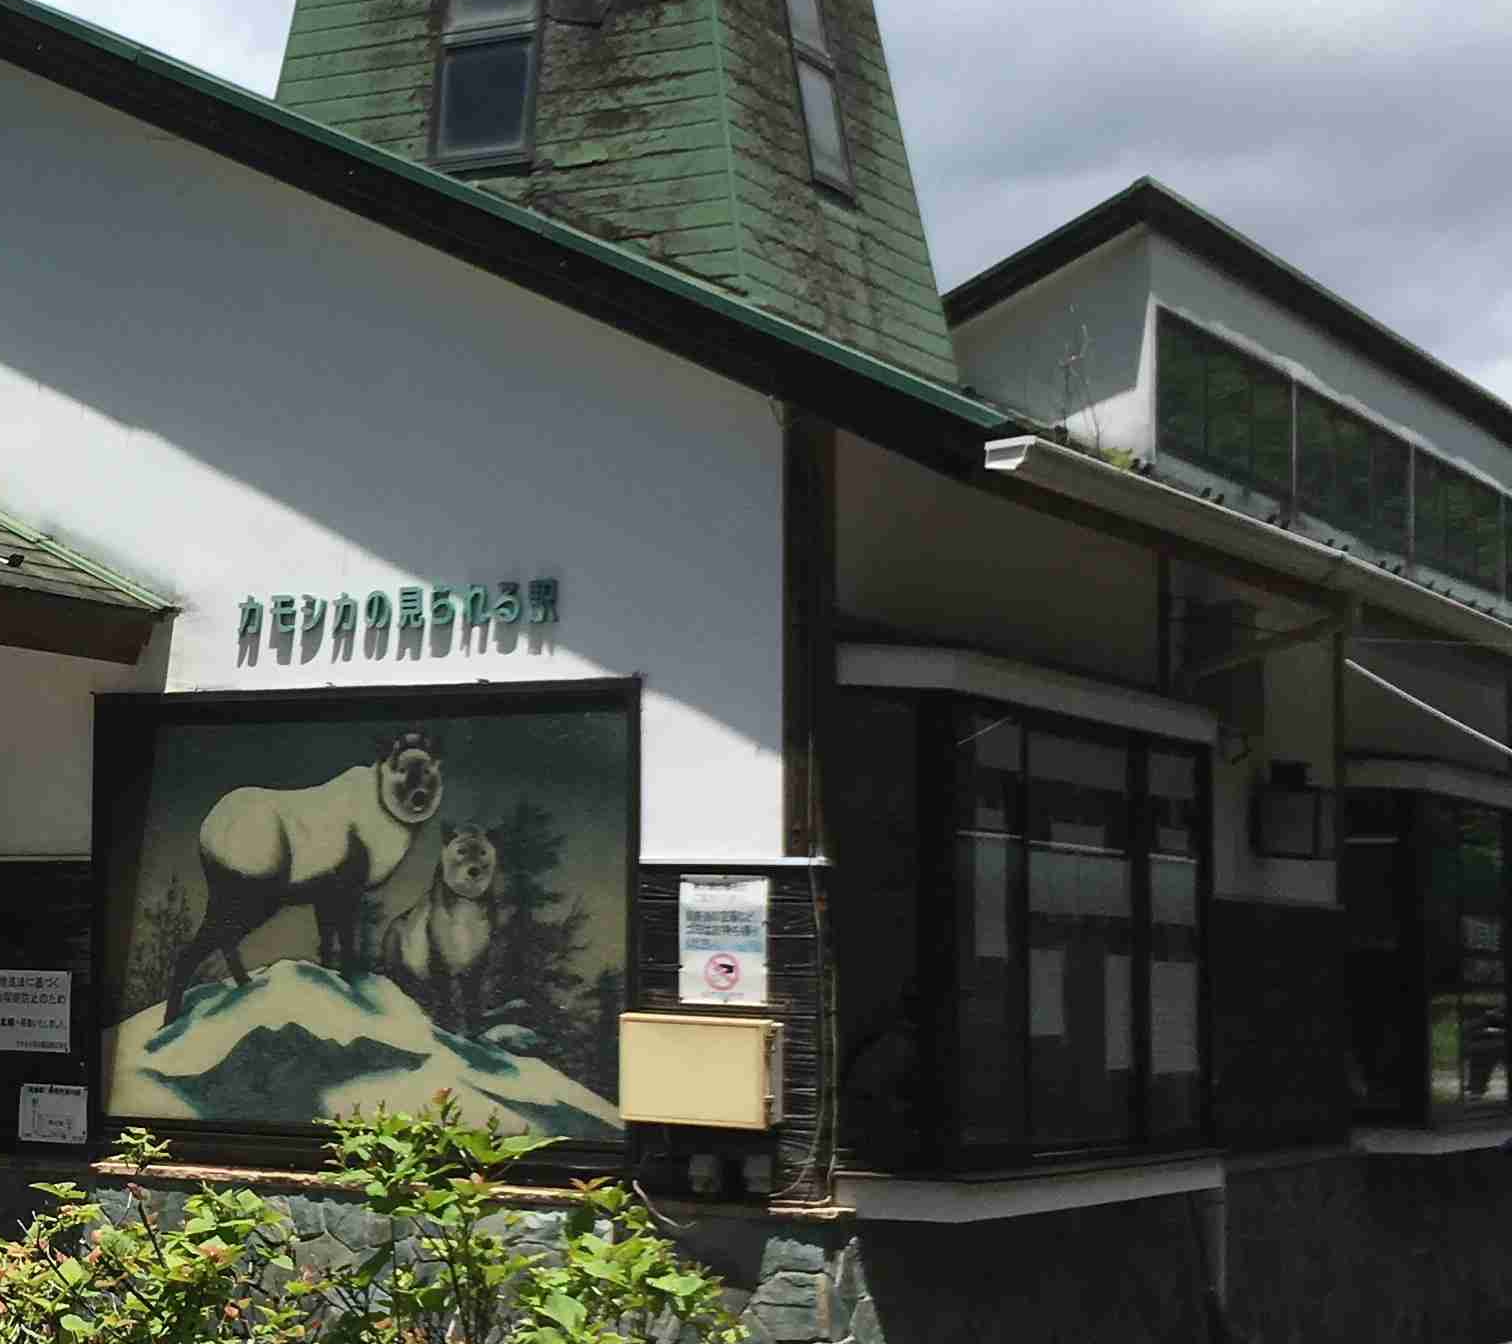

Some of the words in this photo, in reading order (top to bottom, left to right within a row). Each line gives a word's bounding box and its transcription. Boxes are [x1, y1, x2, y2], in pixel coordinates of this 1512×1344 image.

[237, 577, 559, 635] カモシカの見られる駅
